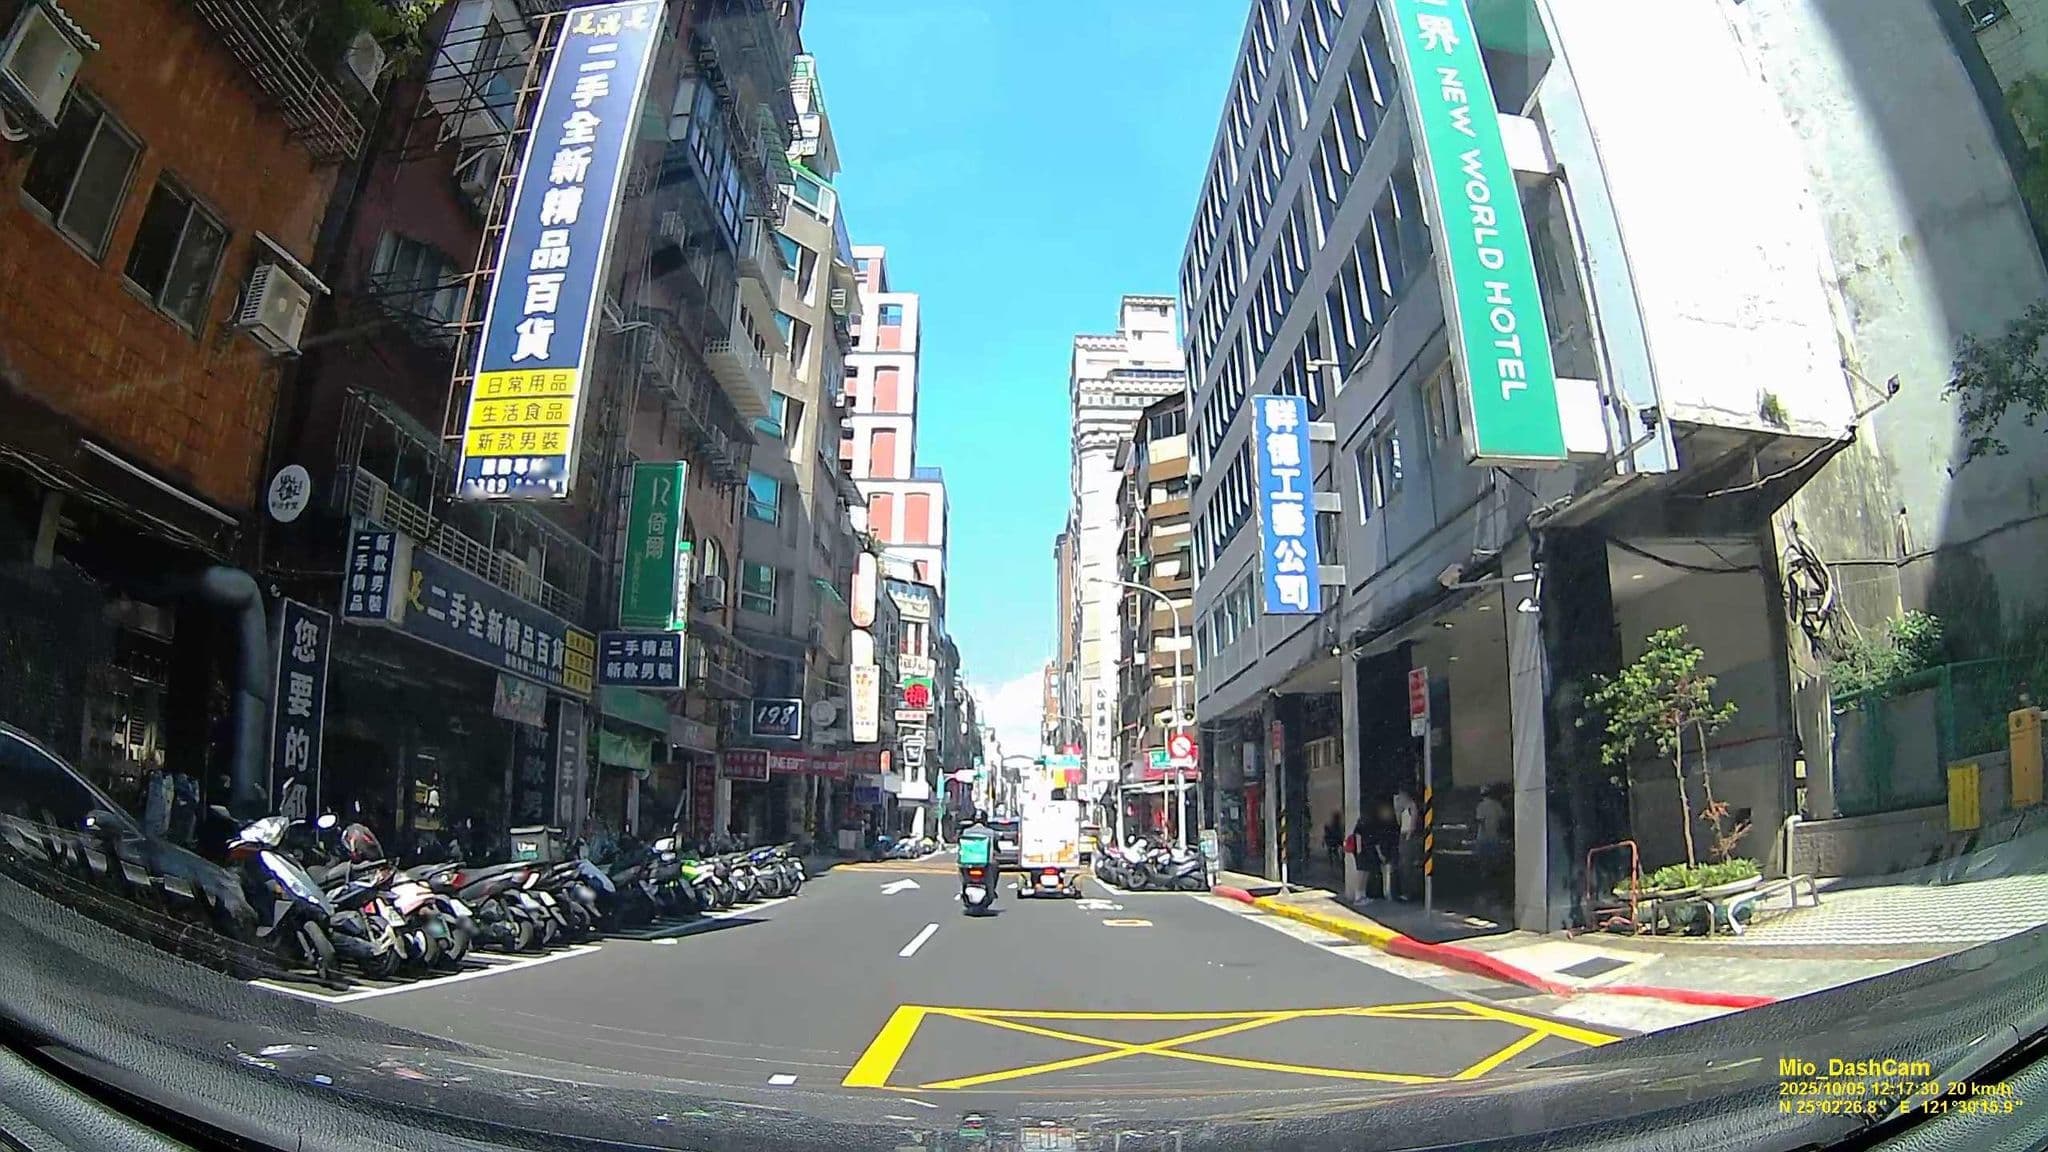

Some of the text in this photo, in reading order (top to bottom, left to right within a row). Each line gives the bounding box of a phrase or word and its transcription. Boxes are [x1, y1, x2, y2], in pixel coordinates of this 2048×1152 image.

[1416, 0, 1461, 56] 界
[511, 43, 617, 362] 二手全新精品百貨
[1436, 65, 1528, 402] NEW WORLD HOTEL
[488, 374, 567, 394] 日常用品
[481, 402, 563, 422] 生活食品
[477, 431, 560, 451] 新款男裝
[608, 640, 673, 657] 二手精品
[757, 706, 796, 725] 198
